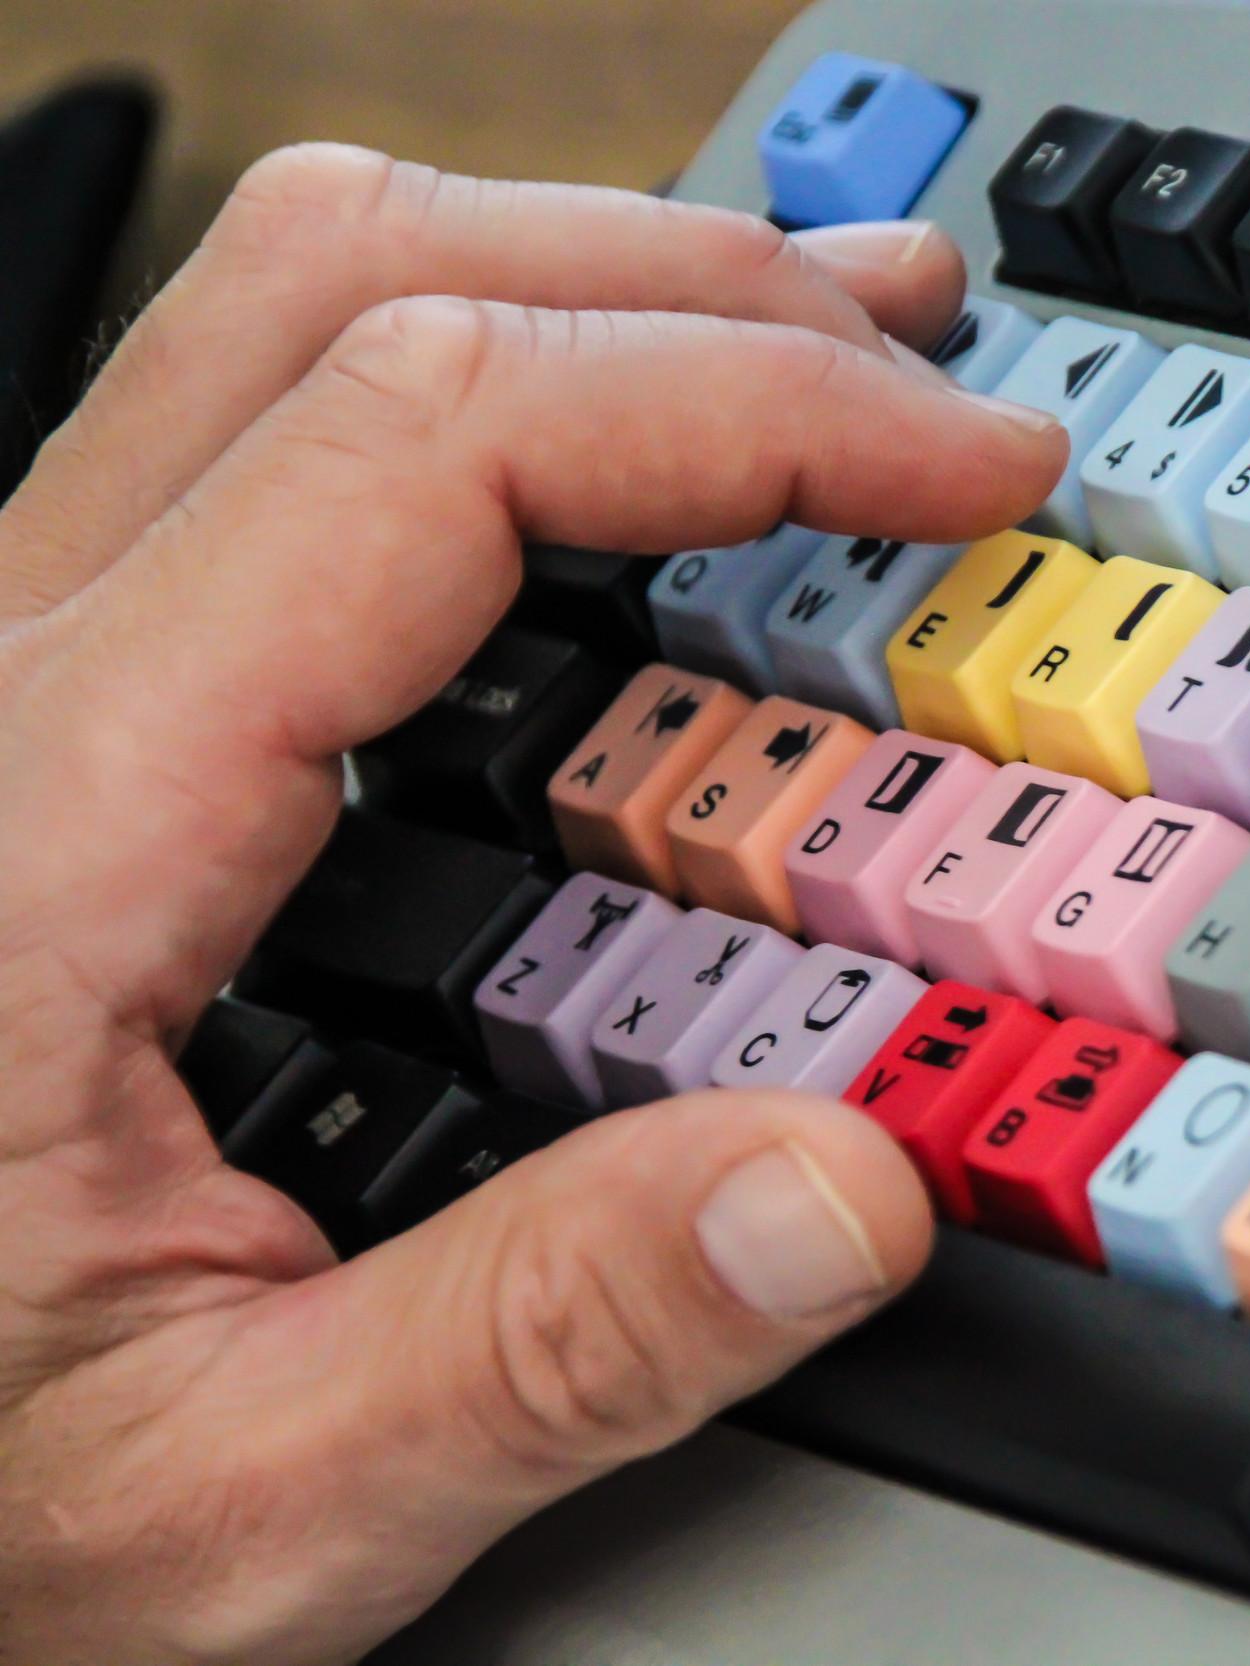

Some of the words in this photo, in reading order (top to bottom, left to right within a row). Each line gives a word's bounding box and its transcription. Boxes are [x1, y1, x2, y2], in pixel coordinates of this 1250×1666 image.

[1023, 142, 1064, 173] F1
[1141, 164, 1188, 197] F2
[1105, 440, 1135, 470] 4
[671, 556, 706, 594] Q
[787, 584, 836, 625] W
[906, 612, 947, 648] E
[1029, 646, 1070, 682] R
[1167, 677, 1204, 711] T
[570, 753, 607, 787] A
[691, 783, 726, 820] S
[802, 819, 840, 855] D
[924, 851, 962, 884] F
[1055, 891, 1092, 929] G
[1186, 921, 1231, 958] H
[497, 959, 539, 996] Z
[612, 997, 656, 1033] X
[739, 1032, 776, 1068] C
[862, 1069, 900, 1105] V
[986, 1109, 1026, 1147] B
[1106, 1148, 1158, 1184] N
